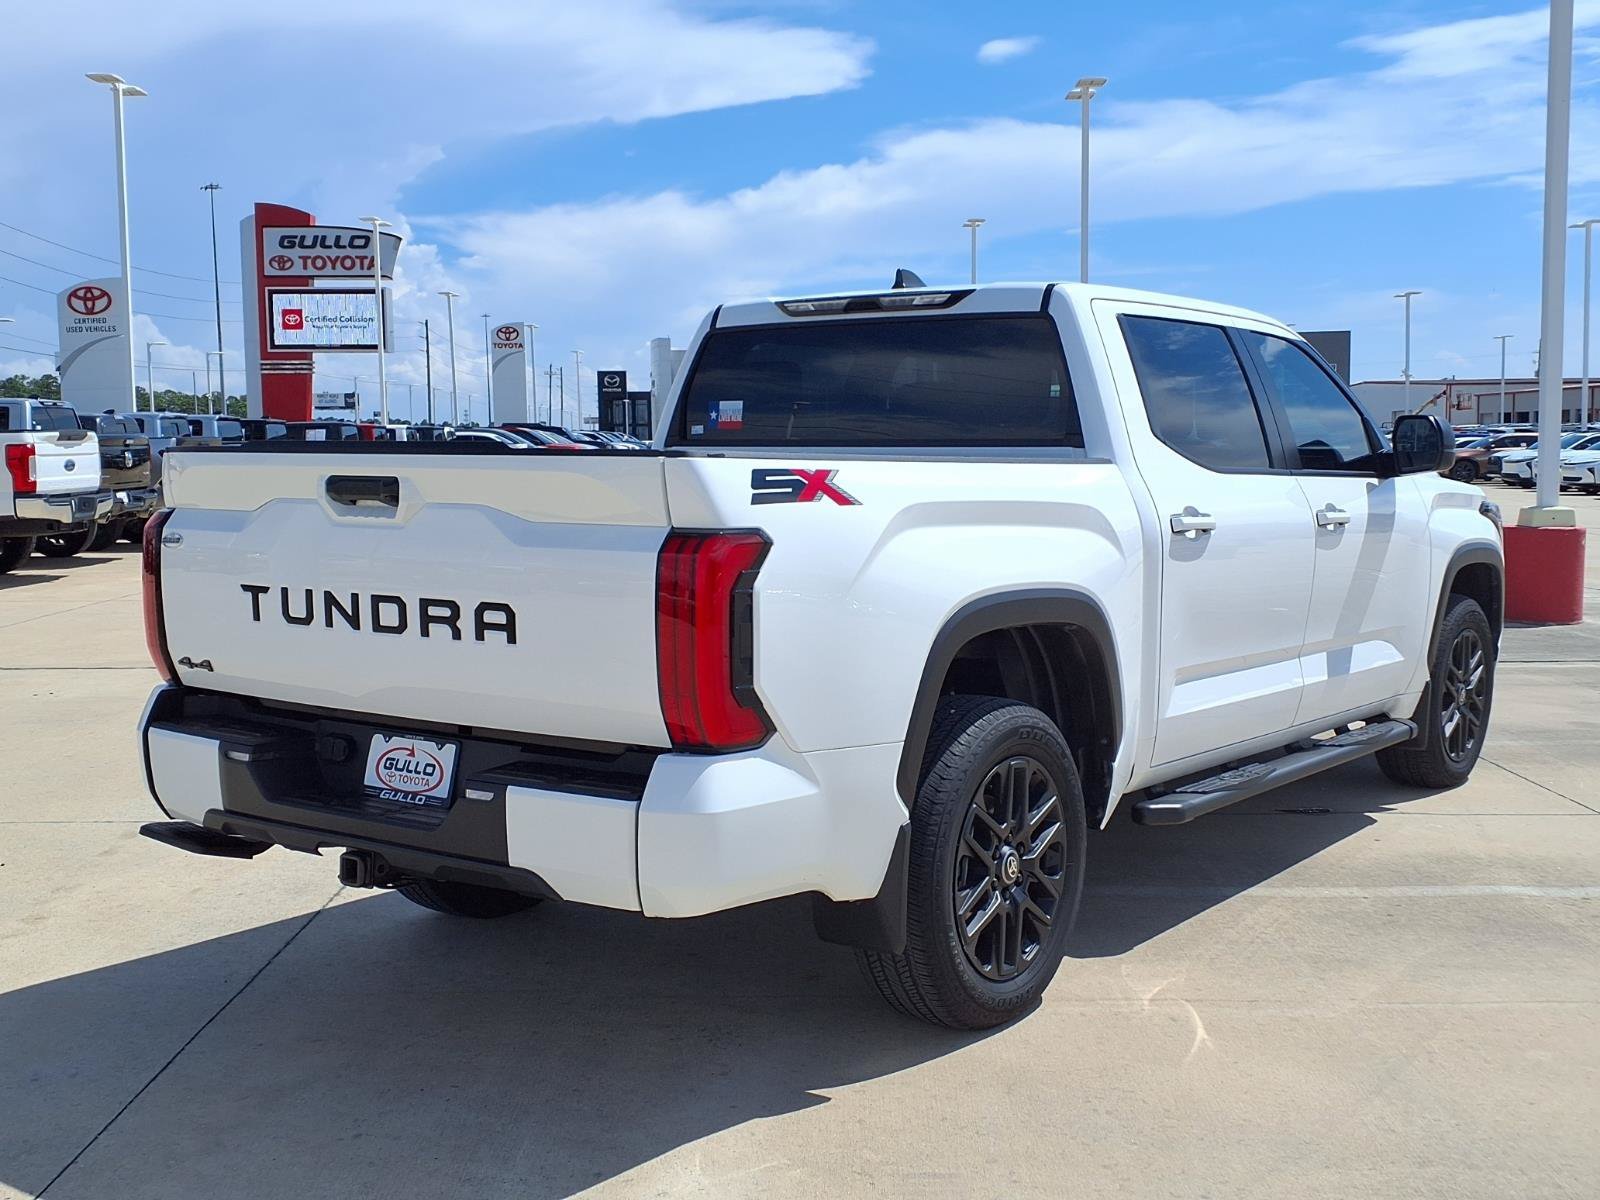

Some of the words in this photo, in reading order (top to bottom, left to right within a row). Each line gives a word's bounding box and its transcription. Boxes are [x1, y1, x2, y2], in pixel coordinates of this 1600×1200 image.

[278, 235, 370, 249] GULLO
[304, 315, 338, 323] Certified
[339, 315, 374, 323] Collision
[240, 584, 517, 645] TUNDRA
[383, 757, 437, 777] GULLO
[398, 774, 430, 787] TOYOTA
[380, 789, 426, 805] GULLO
